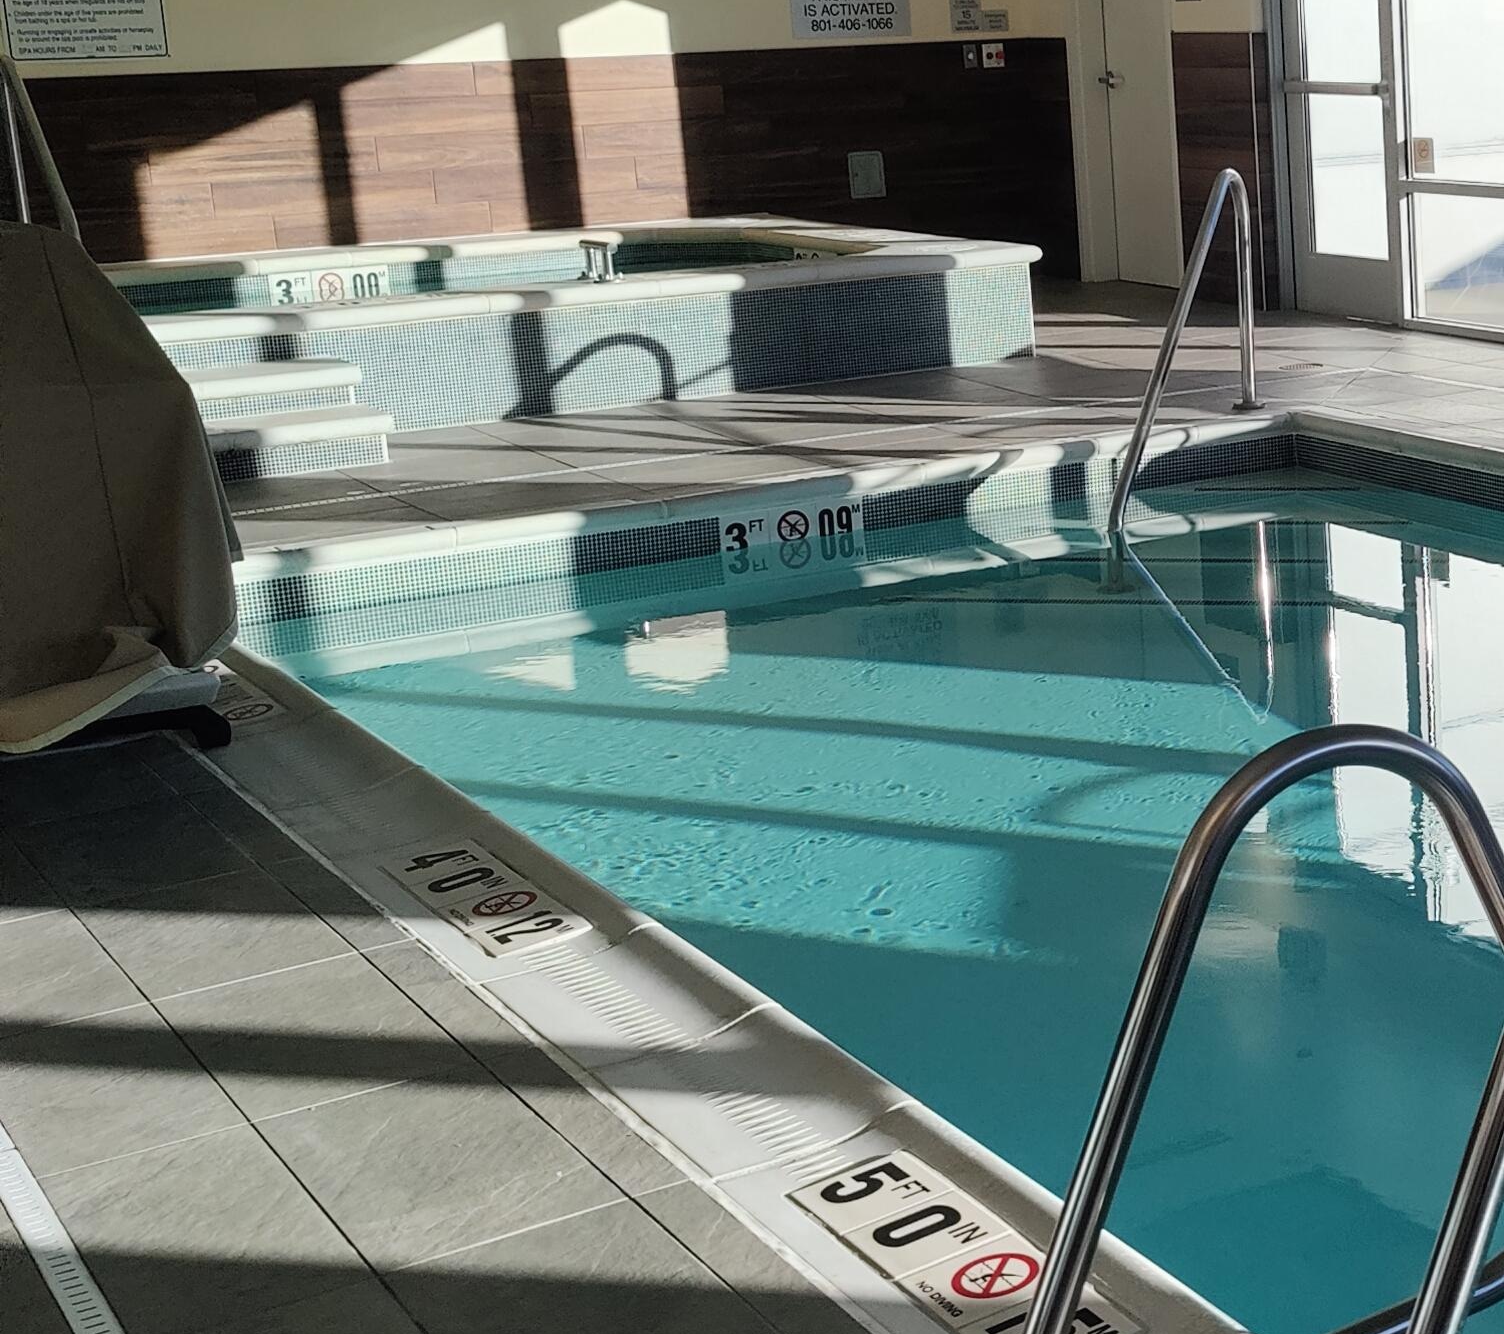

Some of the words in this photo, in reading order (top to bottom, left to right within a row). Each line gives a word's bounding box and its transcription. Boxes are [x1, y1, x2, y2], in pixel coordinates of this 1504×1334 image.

[803, 4, 817, 17] IS
[821, 2, 898, 16] ACTIVATED.
[811, 17, 893, 32] 801-406-1066
[725, 522, 748, 552] 3
[748, 518, 765, 533] FT
[818, 505, 853, 537] 09
[404, 849, 469, 873] 4
[451, 854, 480, 866] FT
[427, 867, 495, 893] 0
[480, 875, 509, 890] IN
[820, 1161, 911, 1204] 5
[890, 1179, 931, 1200] FT
[872, 1204, 962, 1248] 0
[947, 1221, 988, 1244] IN
[915, 1280, 933, 1293] NO
[930, 1292, 964, 1318] DIVING
